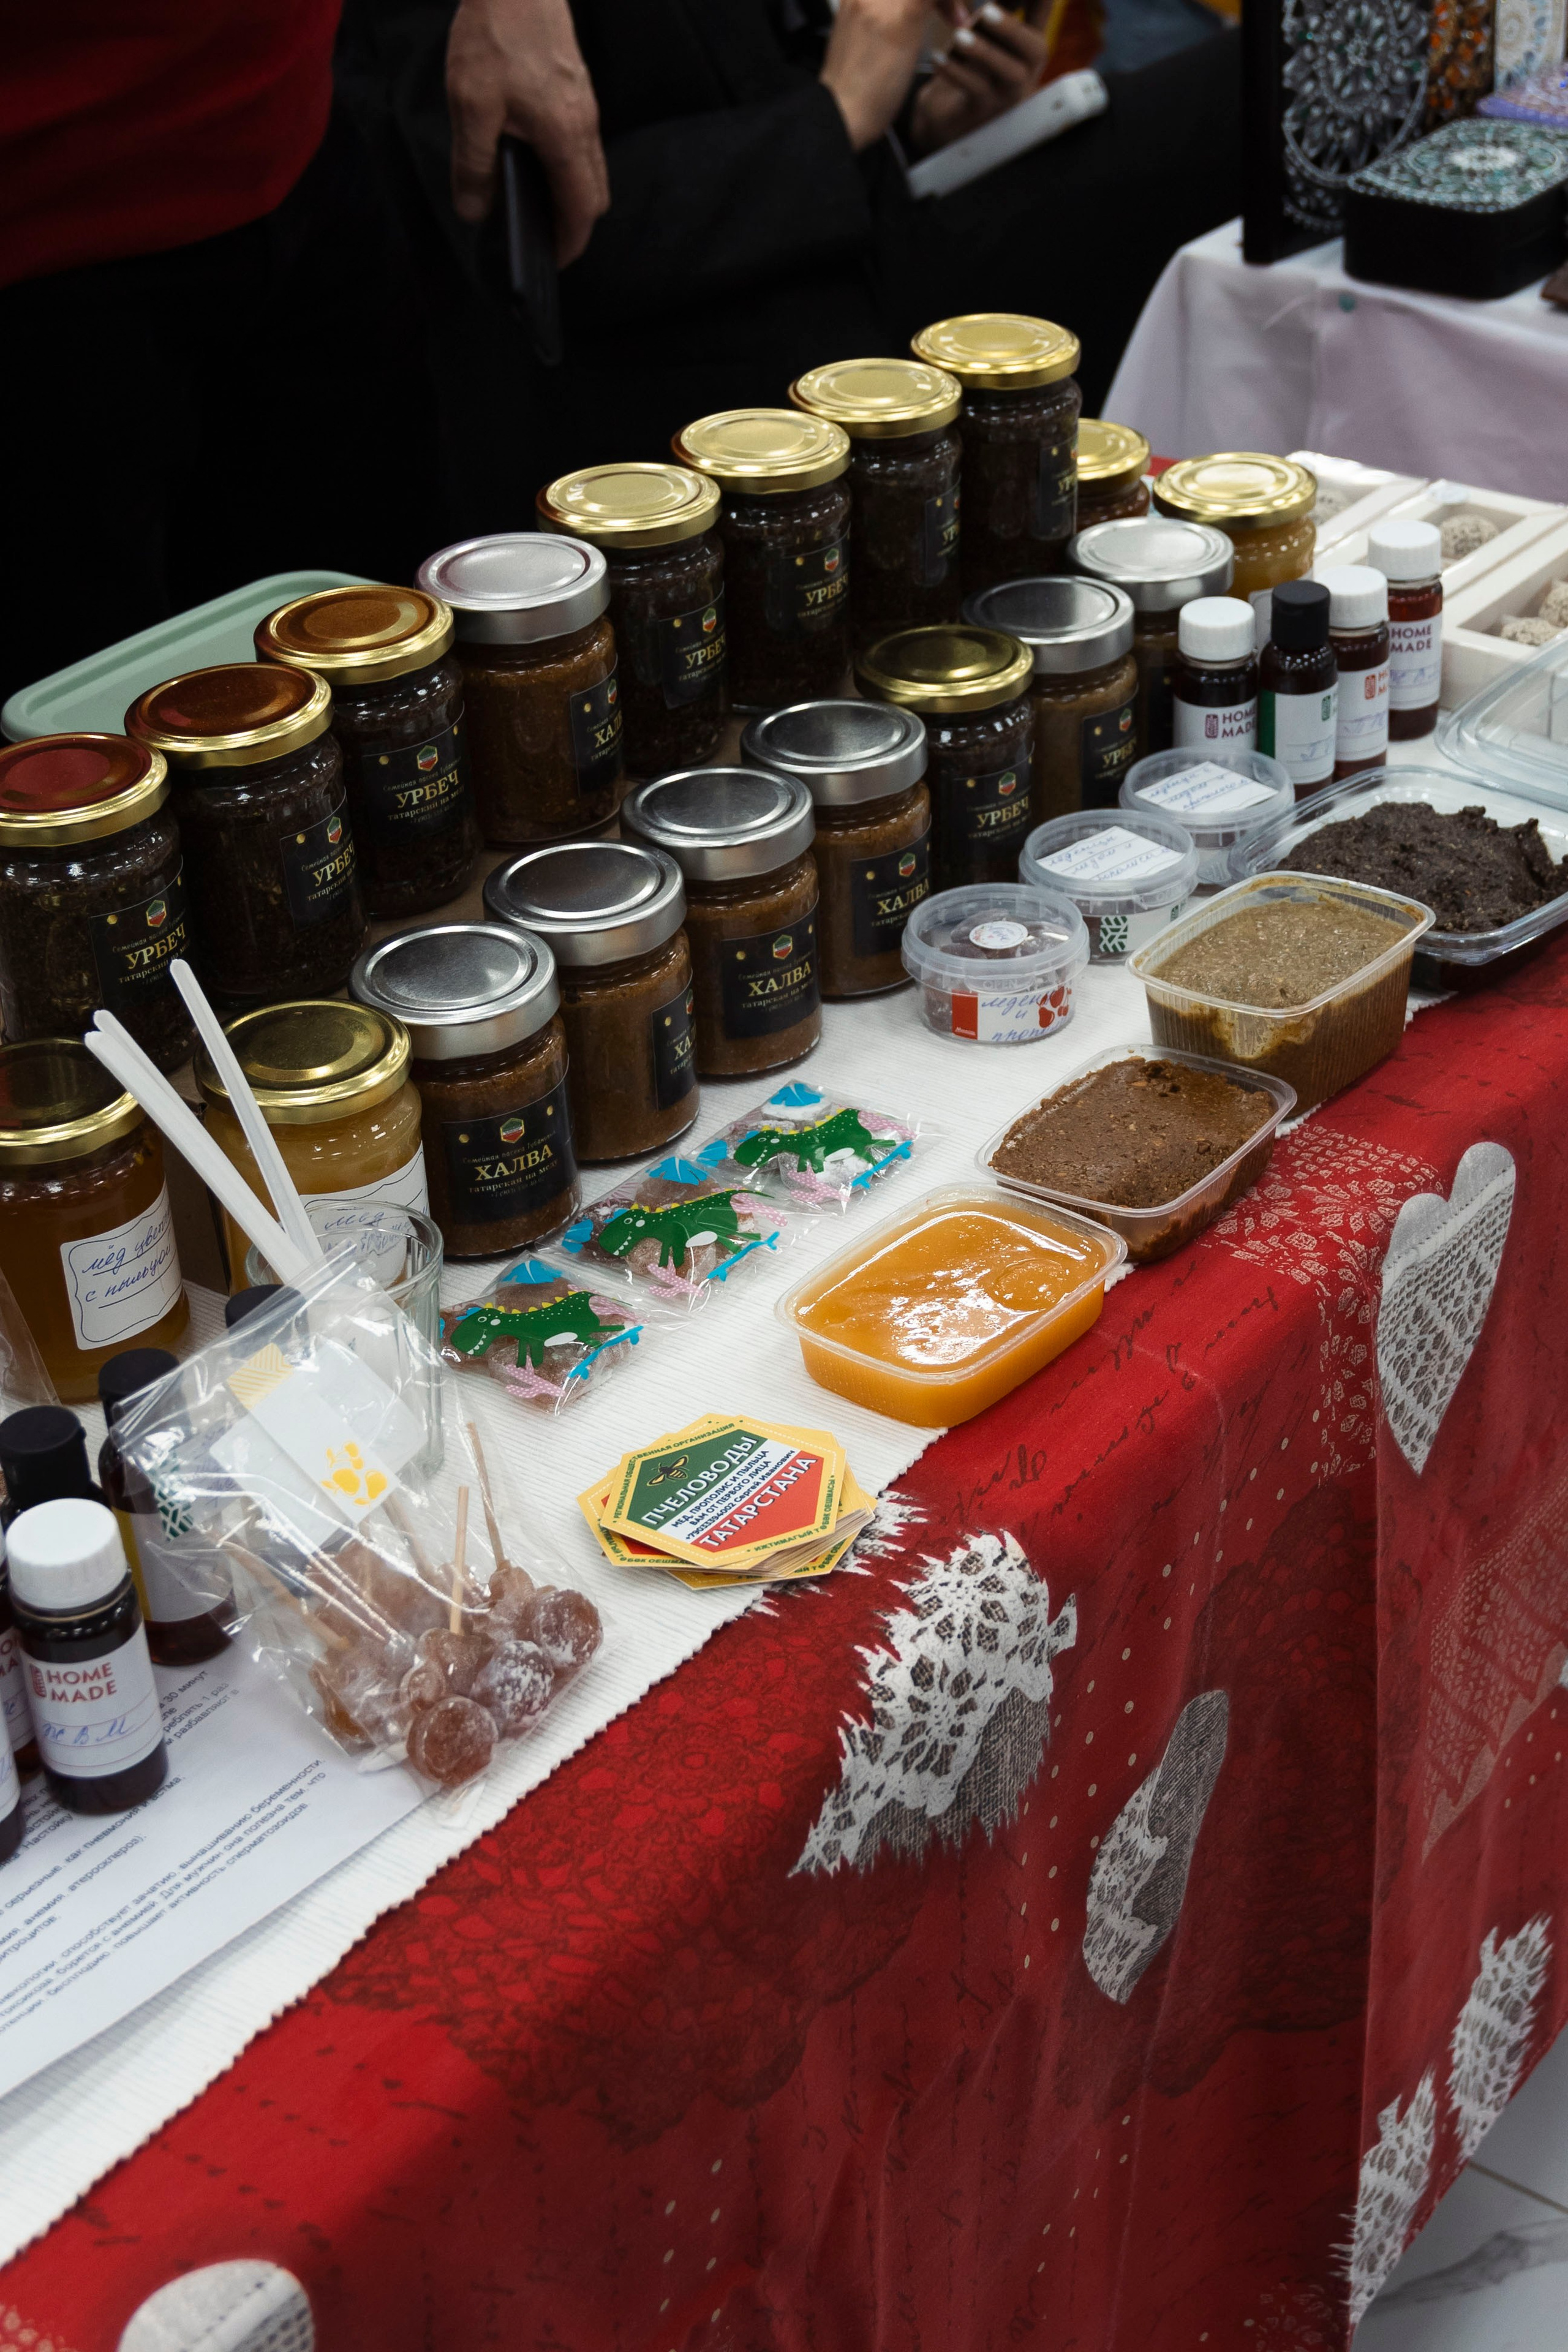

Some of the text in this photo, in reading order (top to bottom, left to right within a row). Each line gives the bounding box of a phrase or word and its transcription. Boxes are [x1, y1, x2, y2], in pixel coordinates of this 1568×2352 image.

[1390, 637, 1433, 652] MADE
[1392, 624, 1432, 639] HOME
[395, 769, 459, 809] УРБЕЧ
[388, 801, 439, 821] татарский
[976, 795, 1029, 829] УРБЕЧ
[312, 839, 355, 888] УРБЕЧ
[876, 878, 930, 916] ХАЛВА
[125, 922, 186, 970] УРБЕЧ
[747, 960, 812, 997] ХАЛВА
[469, 1177, 522, 1194] татарская
[525, 1171, 537, 1182] на
[473, 1144, 553, 1182] ХАЛВА
[82, 1244, 126, 1275] мёд
[613, 1478, 629, 1519] РЕГИОНАЛЬНАЯ
[673, 1422, 736, 1447] ОРГАНИЗАЦИЯ
[641, 1435, 760, 1526] ПЧЕЛОВОДЫ
[689, 1481, 734, 1515] ПРОПОЛИС
[731, 1475, 740, 1483] И
[736, 1449, 769, 1478] ПЫЛЬЦА
[685, 1449, 795, 1540] +79033394002 Сергей Иванович
[689, 1460, 772, 1526] ВАМ ОТ ПЕРВОГО ЛИЦА
[698, 1457, 818, 1547] ТАТАРСТАНА
[47, 1662, 113, 1685] HOME
[51, 1679, 118, 1703] MADE
[162, 1668, 208, 1703] 30 минут
[162, 1703, 203, 1733] реблять
[173, 1694, 230, 1739] разбавляют
[65, 1848, 85, 1863] как
[83, 1803, 141, 1849] пневмония
[56, 1942, 102, 1975] борется
[159, 1882, 184, 1901] Для
[183, 1852, 224, 1882] мужчин
[223, 1836, 244, 1851] она
[243, 1803, 286, 1836] полезна
[307, 1772, 326, 1785] что
[61, 1905, 131, 1958] способствует
[179, 1814, 252, 1869] вынашиванию
[113, 1909, 167, 1948] повышает
[168, 1866, 227, 1909] активность
